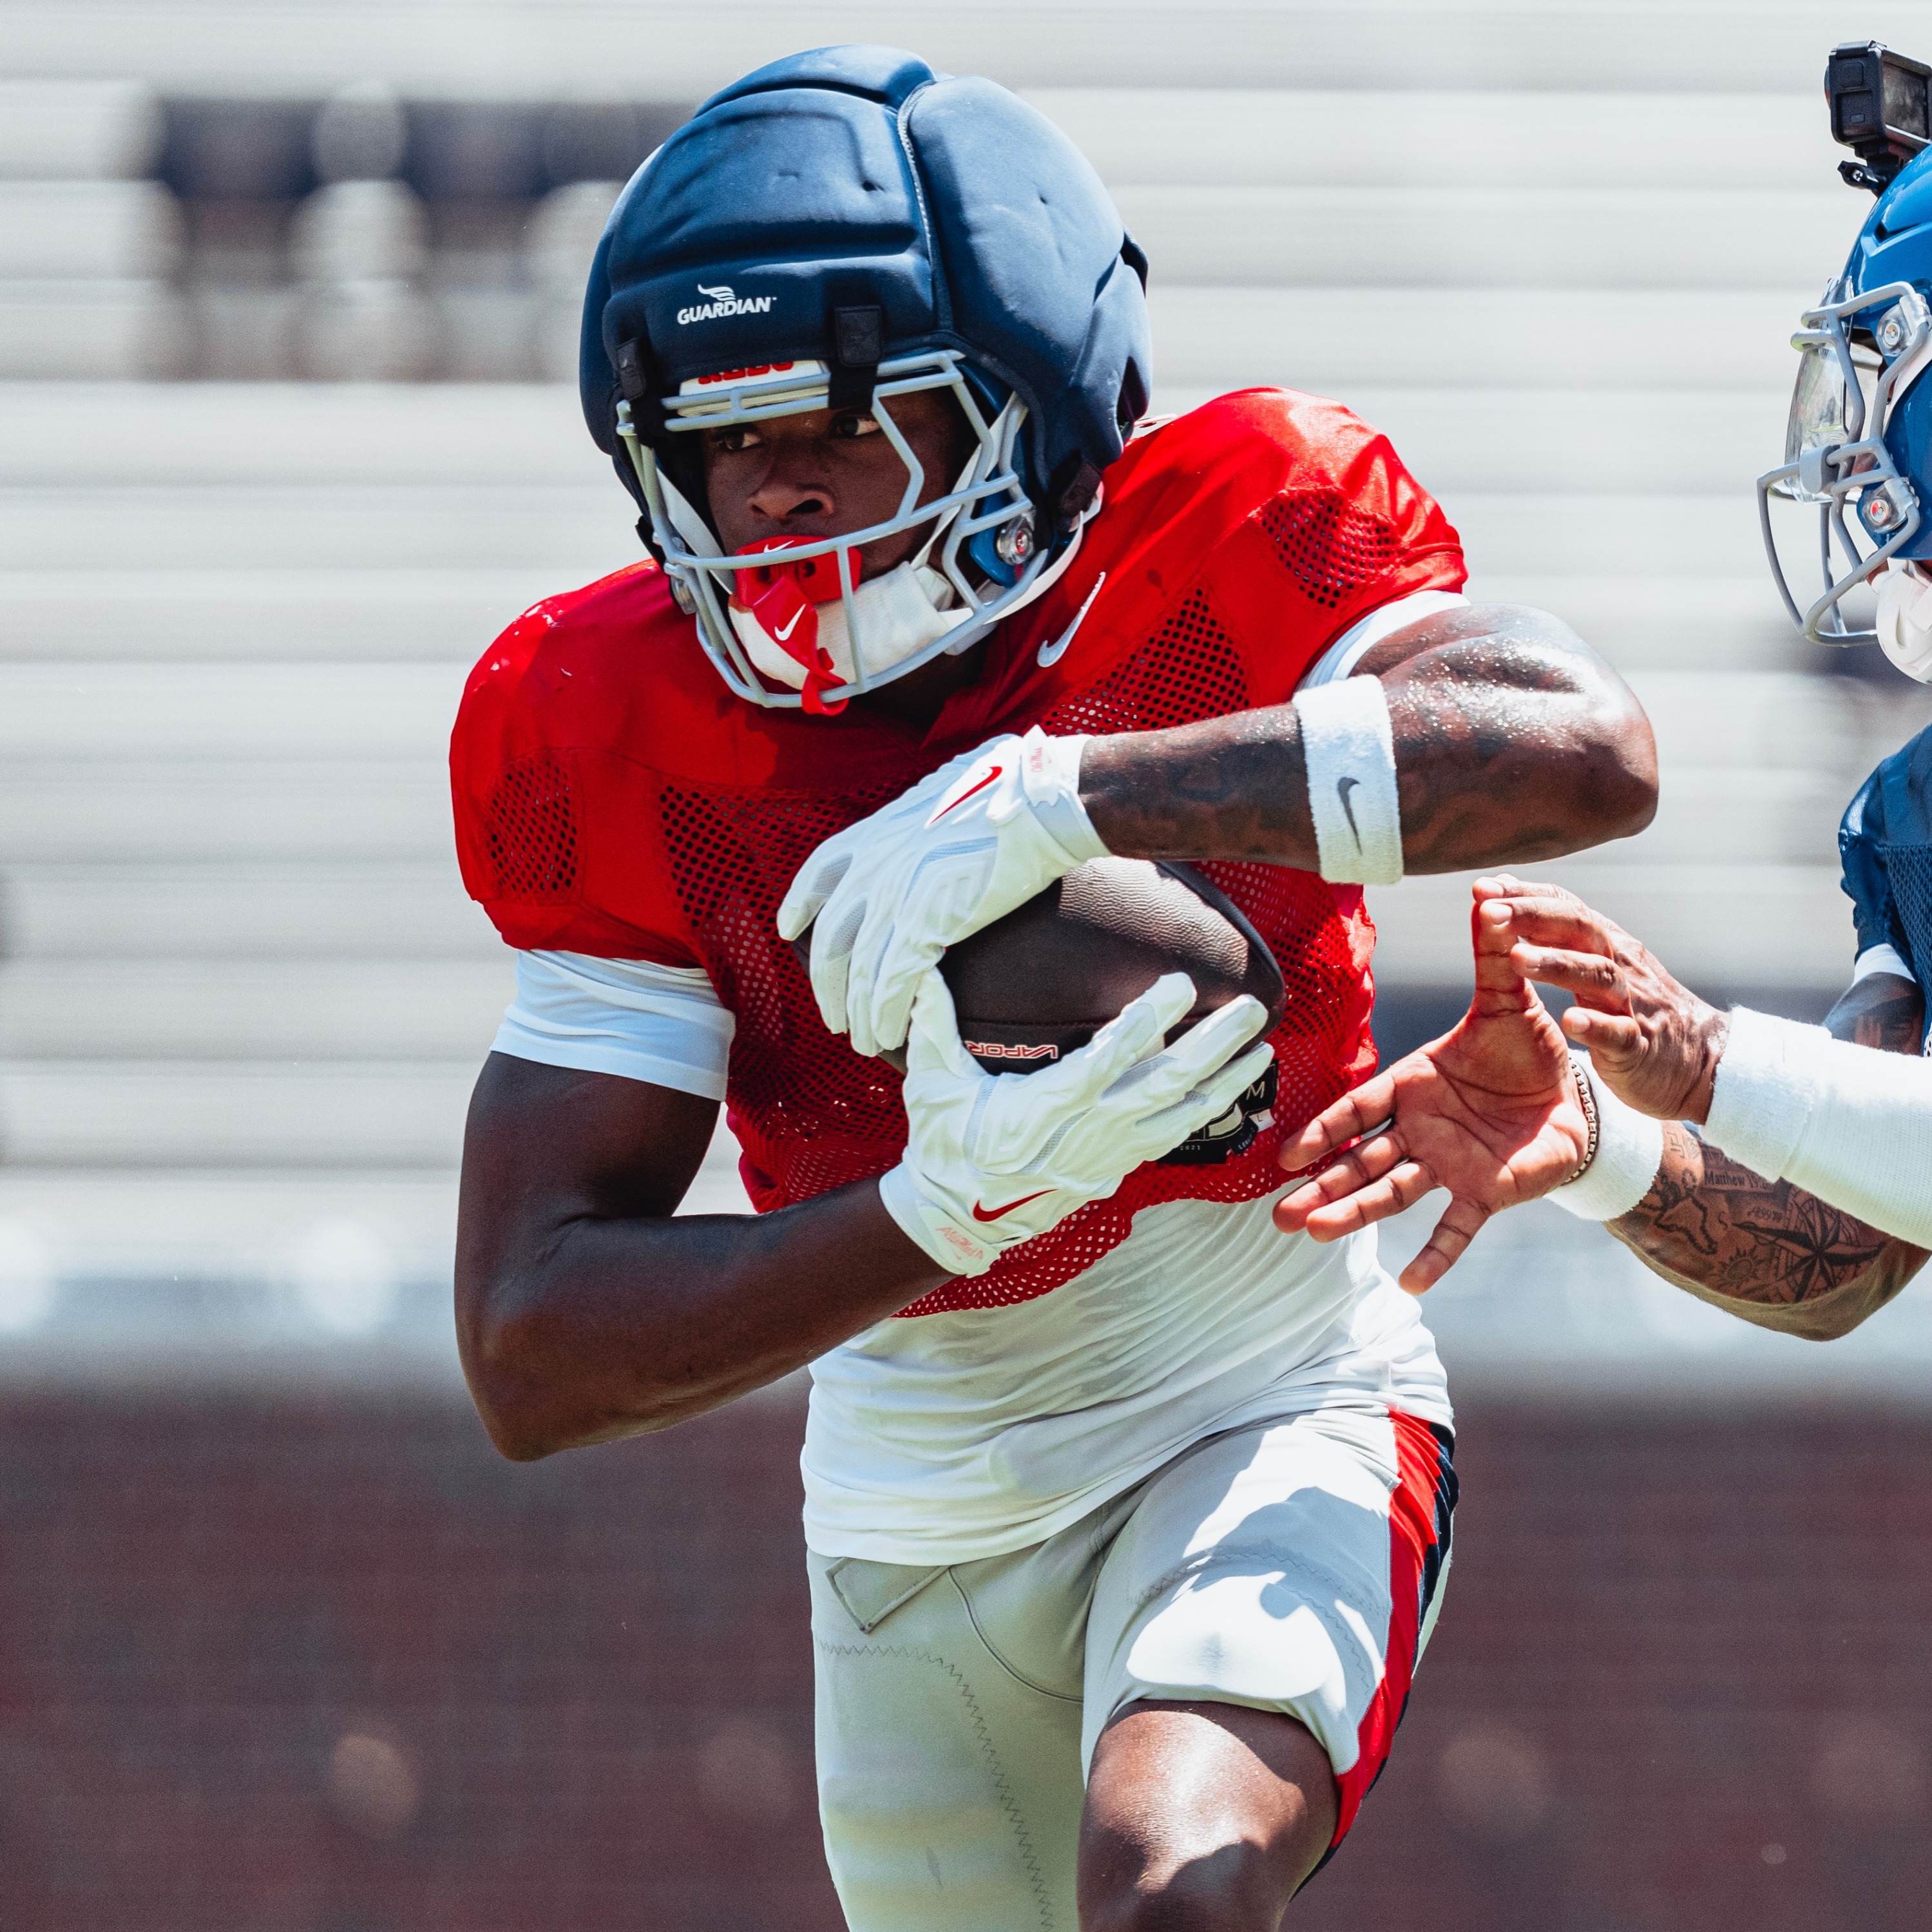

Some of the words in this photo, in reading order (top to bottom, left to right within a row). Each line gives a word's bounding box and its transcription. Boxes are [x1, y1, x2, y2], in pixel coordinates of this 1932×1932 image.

[677, 296, 772, 325] GUARDIAN
[964, 1040, 1058, 1059] VAPOR
[1704, 1169, 1745, 1186] Matthew
